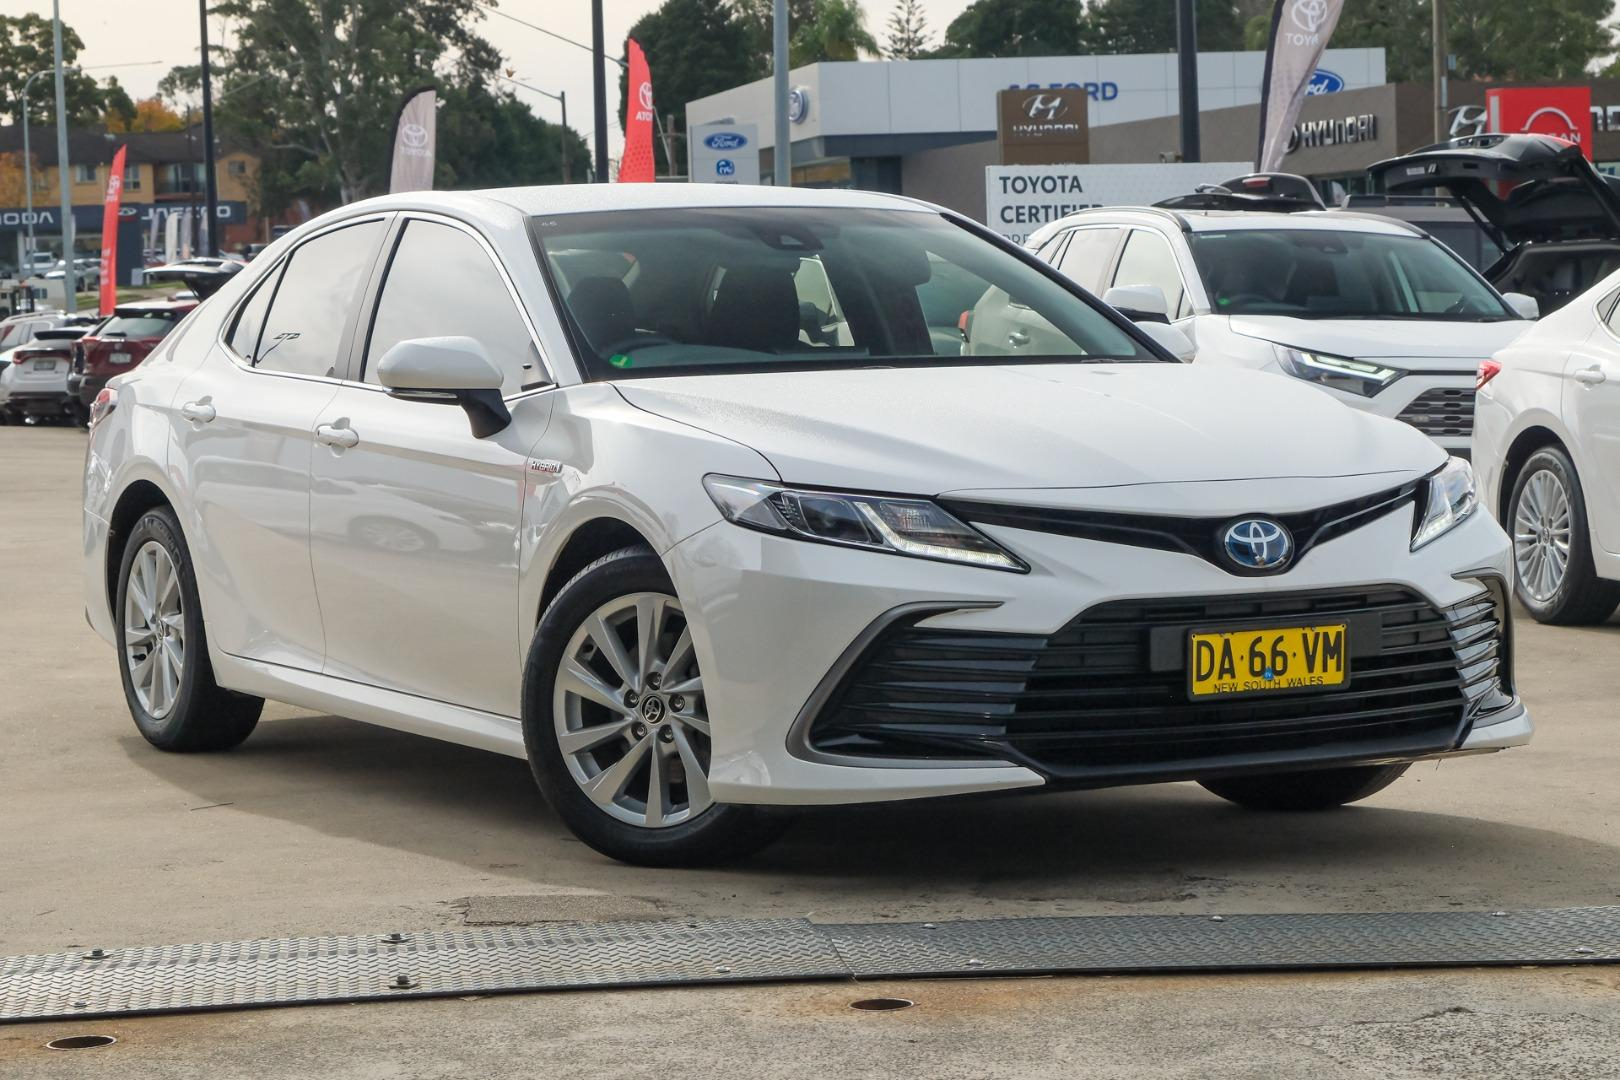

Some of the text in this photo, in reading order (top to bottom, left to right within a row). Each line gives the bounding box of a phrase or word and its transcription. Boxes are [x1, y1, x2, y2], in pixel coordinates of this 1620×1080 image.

[1049, 82, 1119, 102] RD
[1301, 114, 1377, 147] HYUNDAI
[999, 175, 1083, 194] TOYOTA
[0, 211, 54, 225] ODA
[1001, 204, 1104, 223] CERTIF
[1214, 676, 1324, 693] NEW SOUTH WALES
